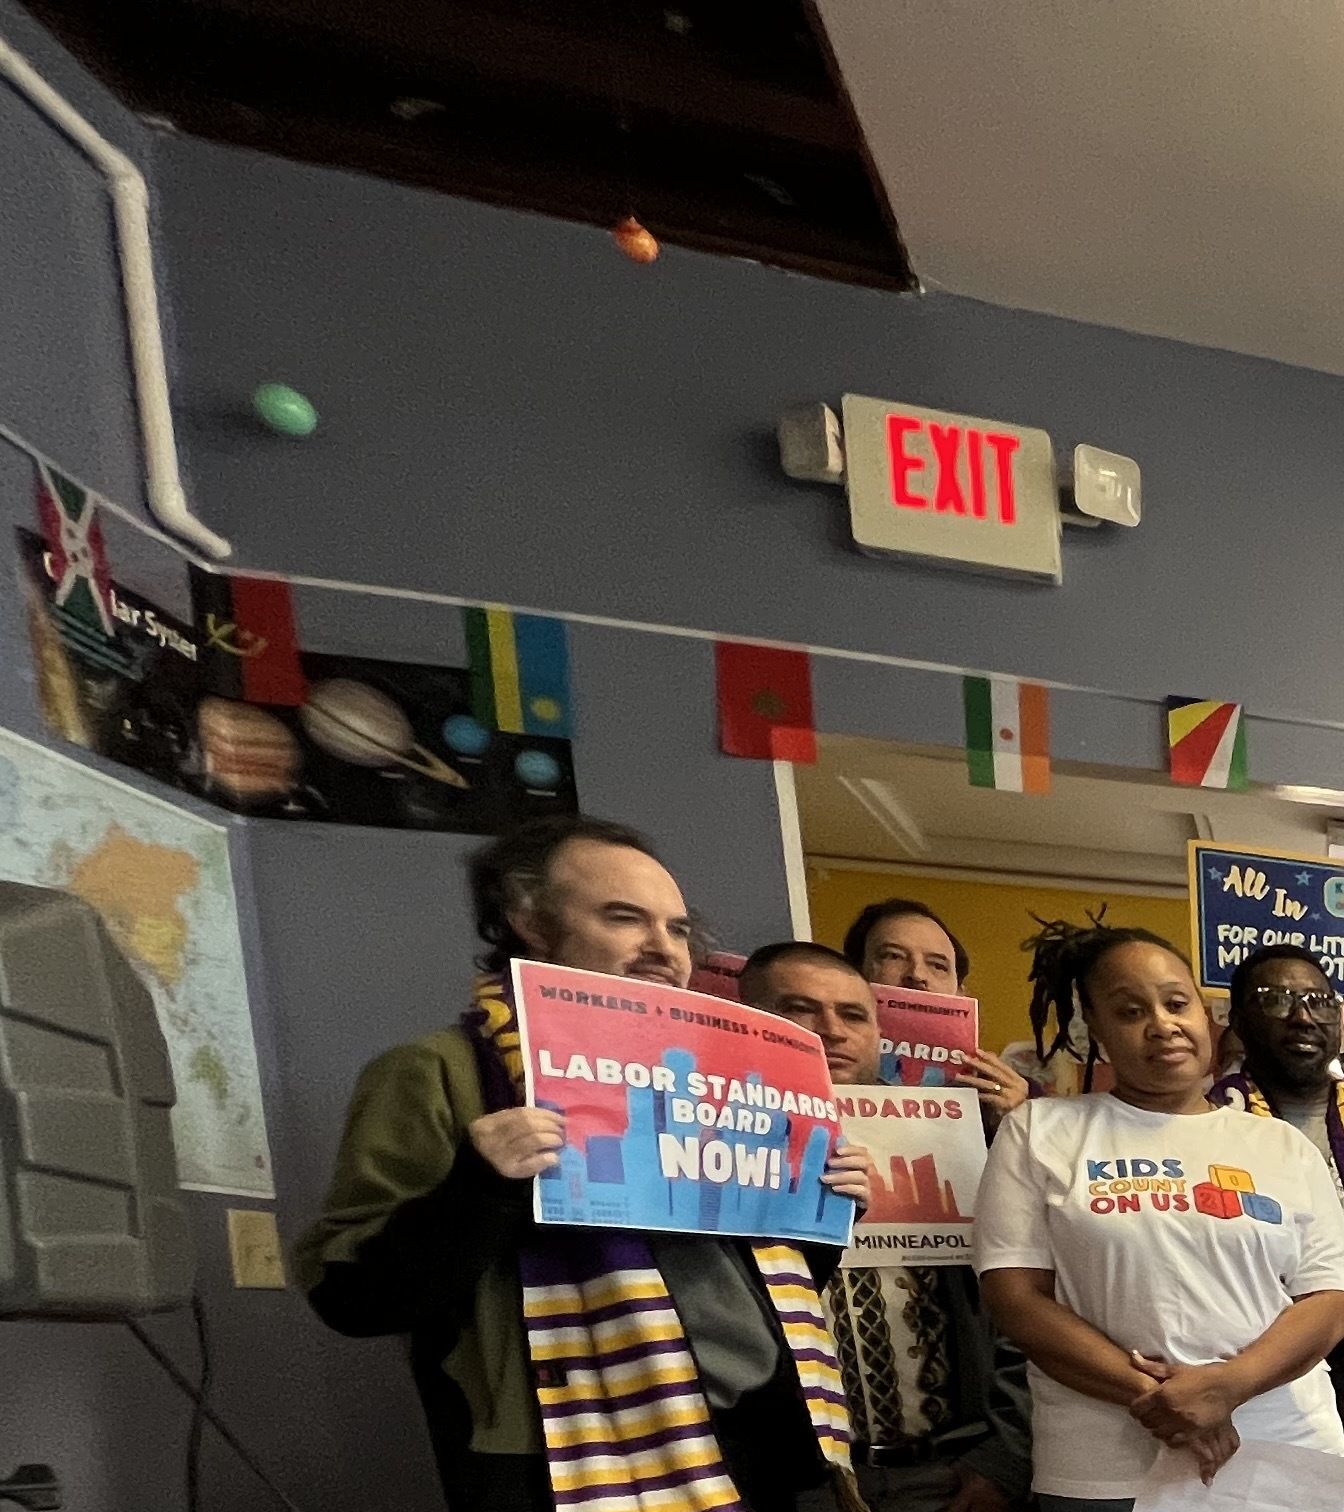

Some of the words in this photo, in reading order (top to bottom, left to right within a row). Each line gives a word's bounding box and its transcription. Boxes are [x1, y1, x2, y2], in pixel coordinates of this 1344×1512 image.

[886, 413, 1020, 526] EXIT
[1222, 864, 1270, 900] All
[1271, 888, 1309, 921] In
[1217, 924, 1258, 945] FOR
[1262, 930, 1306, 949] OUR
[539, 984, 648, 1014] WORKERS
[669, 1007, 749, 1035] BUSINESS
[880, 1038, 967, 1066] DARDS
[538, 1049, 677, 1094] LABOR
[687, 1072, 839, 1123] STANDARDS
[671, 1098, 773, 1136] BOARD
[836, 1097, 963, 1120] NDARDS
[658, 1132, 782, 1190] NOW!
[1086, 1158, 1185, 1181] KIDS
[1088, 1177, 1187, 1196] COUNT
[1089, 1193, 1141, 1215] ON
[1151, 1192, 1190, 1212] US
[853, 1234, 973, 1250] MINNEAPOL
